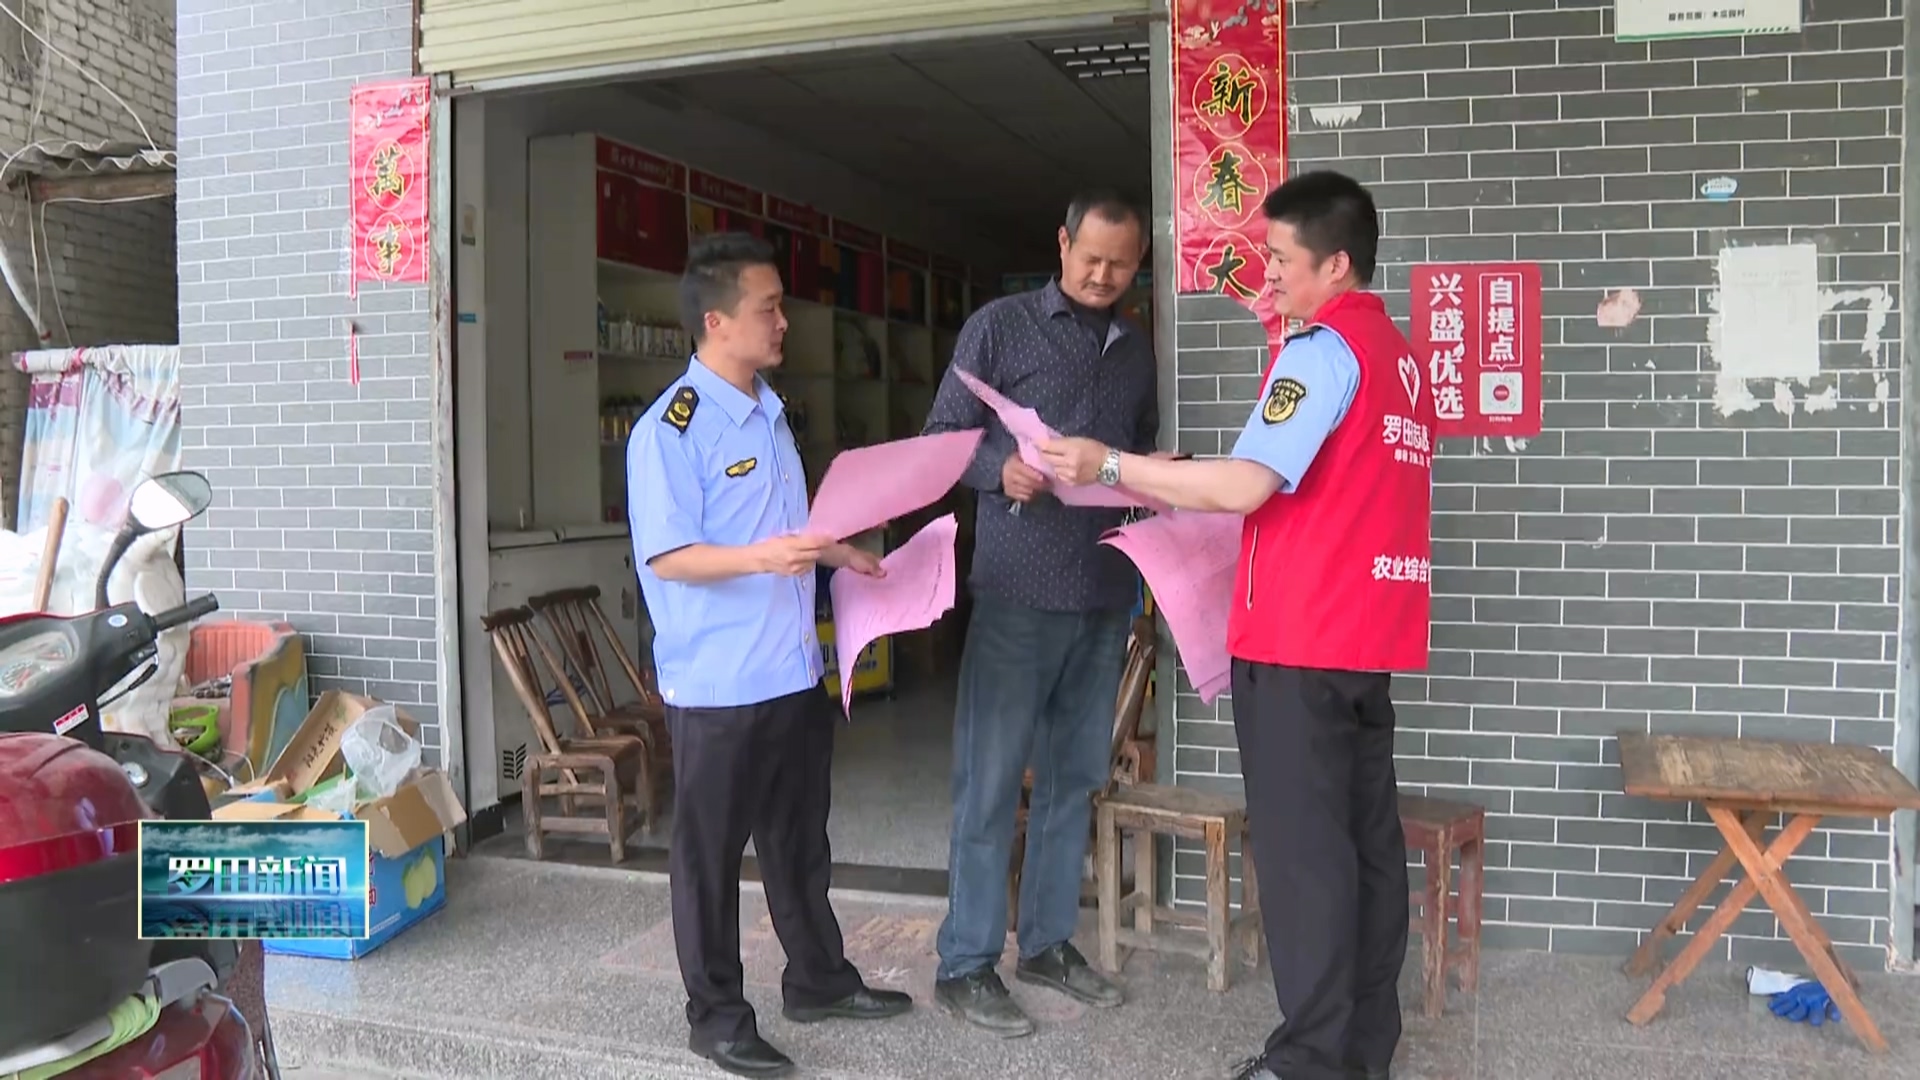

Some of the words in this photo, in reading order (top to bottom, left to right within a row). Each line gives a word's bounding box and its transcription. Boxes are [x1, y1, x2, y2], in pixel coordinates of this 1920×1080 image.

[1428, 273, 1466, 420] 兴盛优选
[1487, 277, 1516, 362] 自提点
